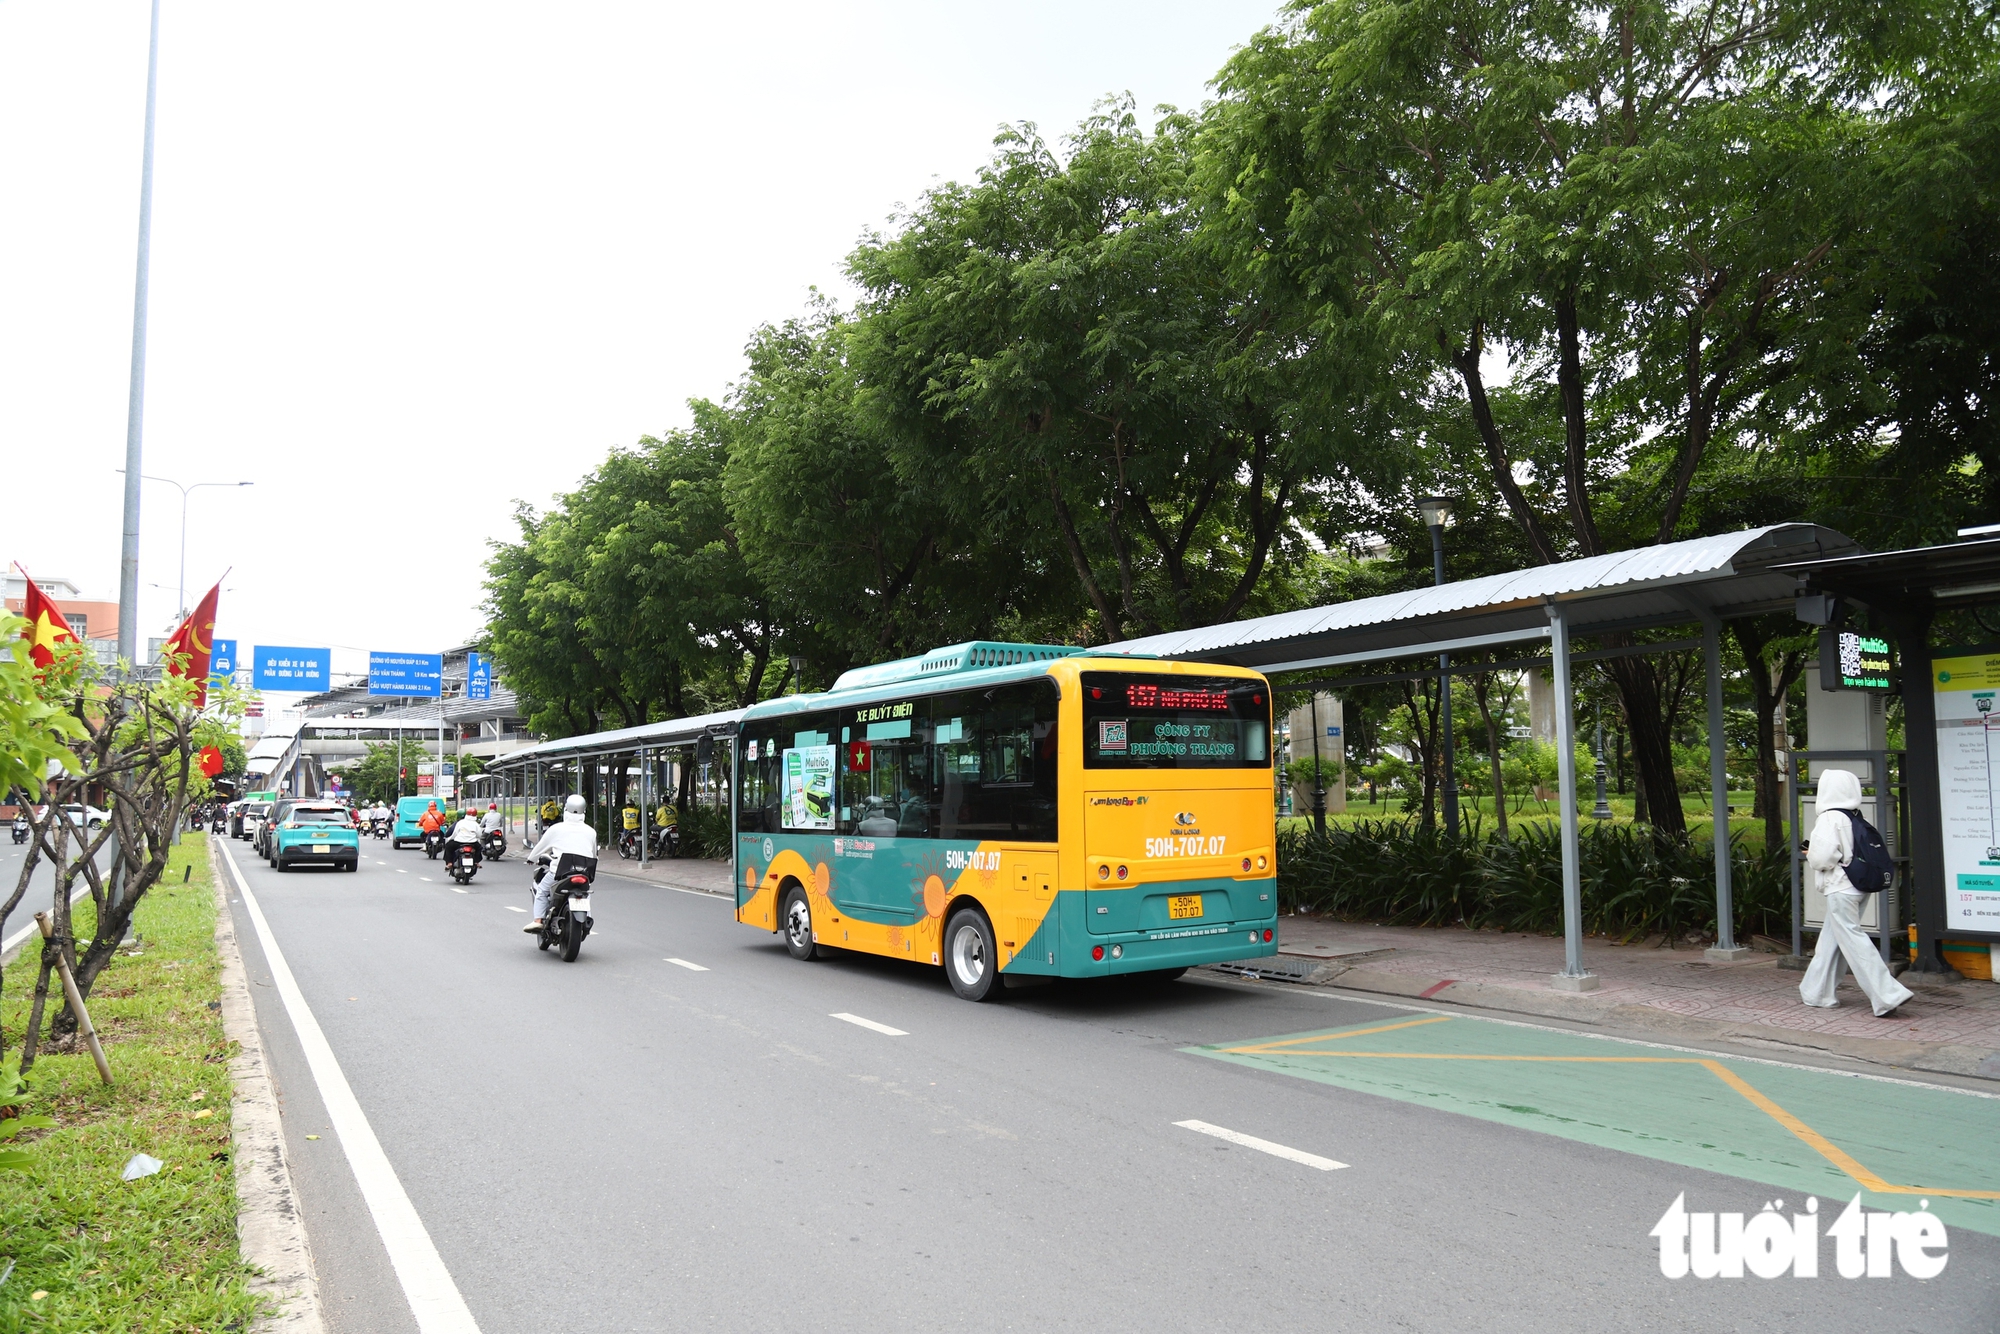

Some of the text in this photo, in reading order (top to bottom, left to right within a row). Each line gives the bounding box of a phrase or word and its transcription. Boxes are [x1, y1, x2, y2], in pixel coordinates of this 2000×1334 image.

[1859, 637, 1889, 654] MultiGo
[292, 660, 298, 668] XE
[390, 669, 405, 677] THÁNH
[1864, 677, 1877, 687] hành
[1127, 685, 1157, 706] 157
[856, 709, 868, 723] XE
[868, 703, 892, 721] BUÝT
[1154, 721, 1211, 737] CÔNG TY
[1130, 740, 1235, 756] PHƯƠNG TRANG
[805, 756, 829, 768] MultiGo
[625, 810, 636, 819] be
[1145, 835, 1226, 858] 50H-707.07
[946, 850, 1001, 871] 50H-707.07
[1960, 894, 1972, 902] 157
[1173, 906, 1199, 918] 707.07
[1962, 909, 1972, 917] 43
